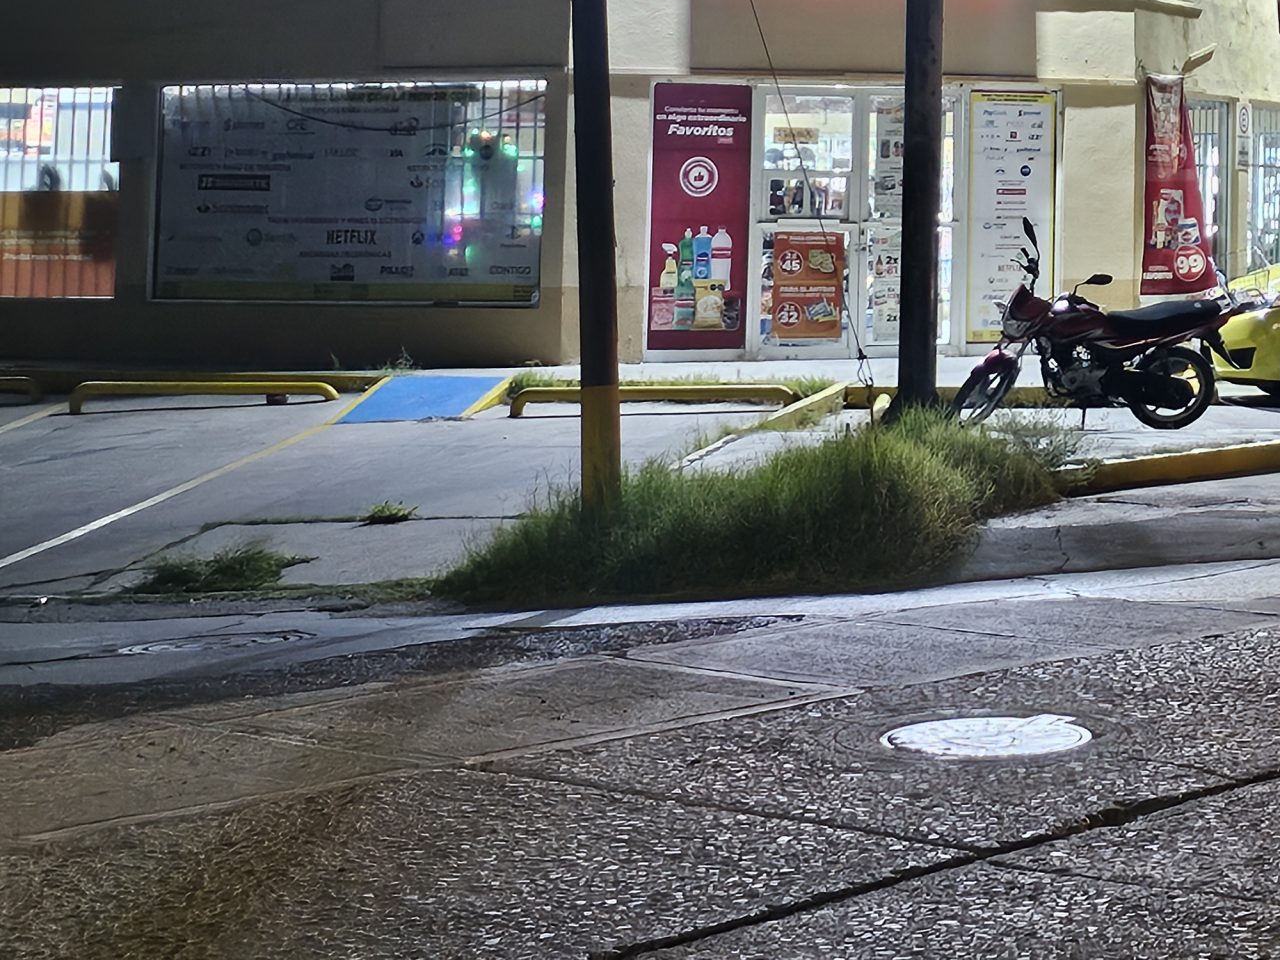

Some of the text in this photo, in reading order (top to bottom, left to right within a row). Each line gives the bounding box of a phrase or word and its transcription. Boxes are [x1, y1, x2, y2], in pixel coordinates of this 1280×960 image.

[667, 123, 734, 136] Favoritos
[326, 228, 377, 245] NETFLIX
[782, 259, 801, 271] 45
[1177, 254, 1204, 274] 99
[777, 311, 799, 323] 32
